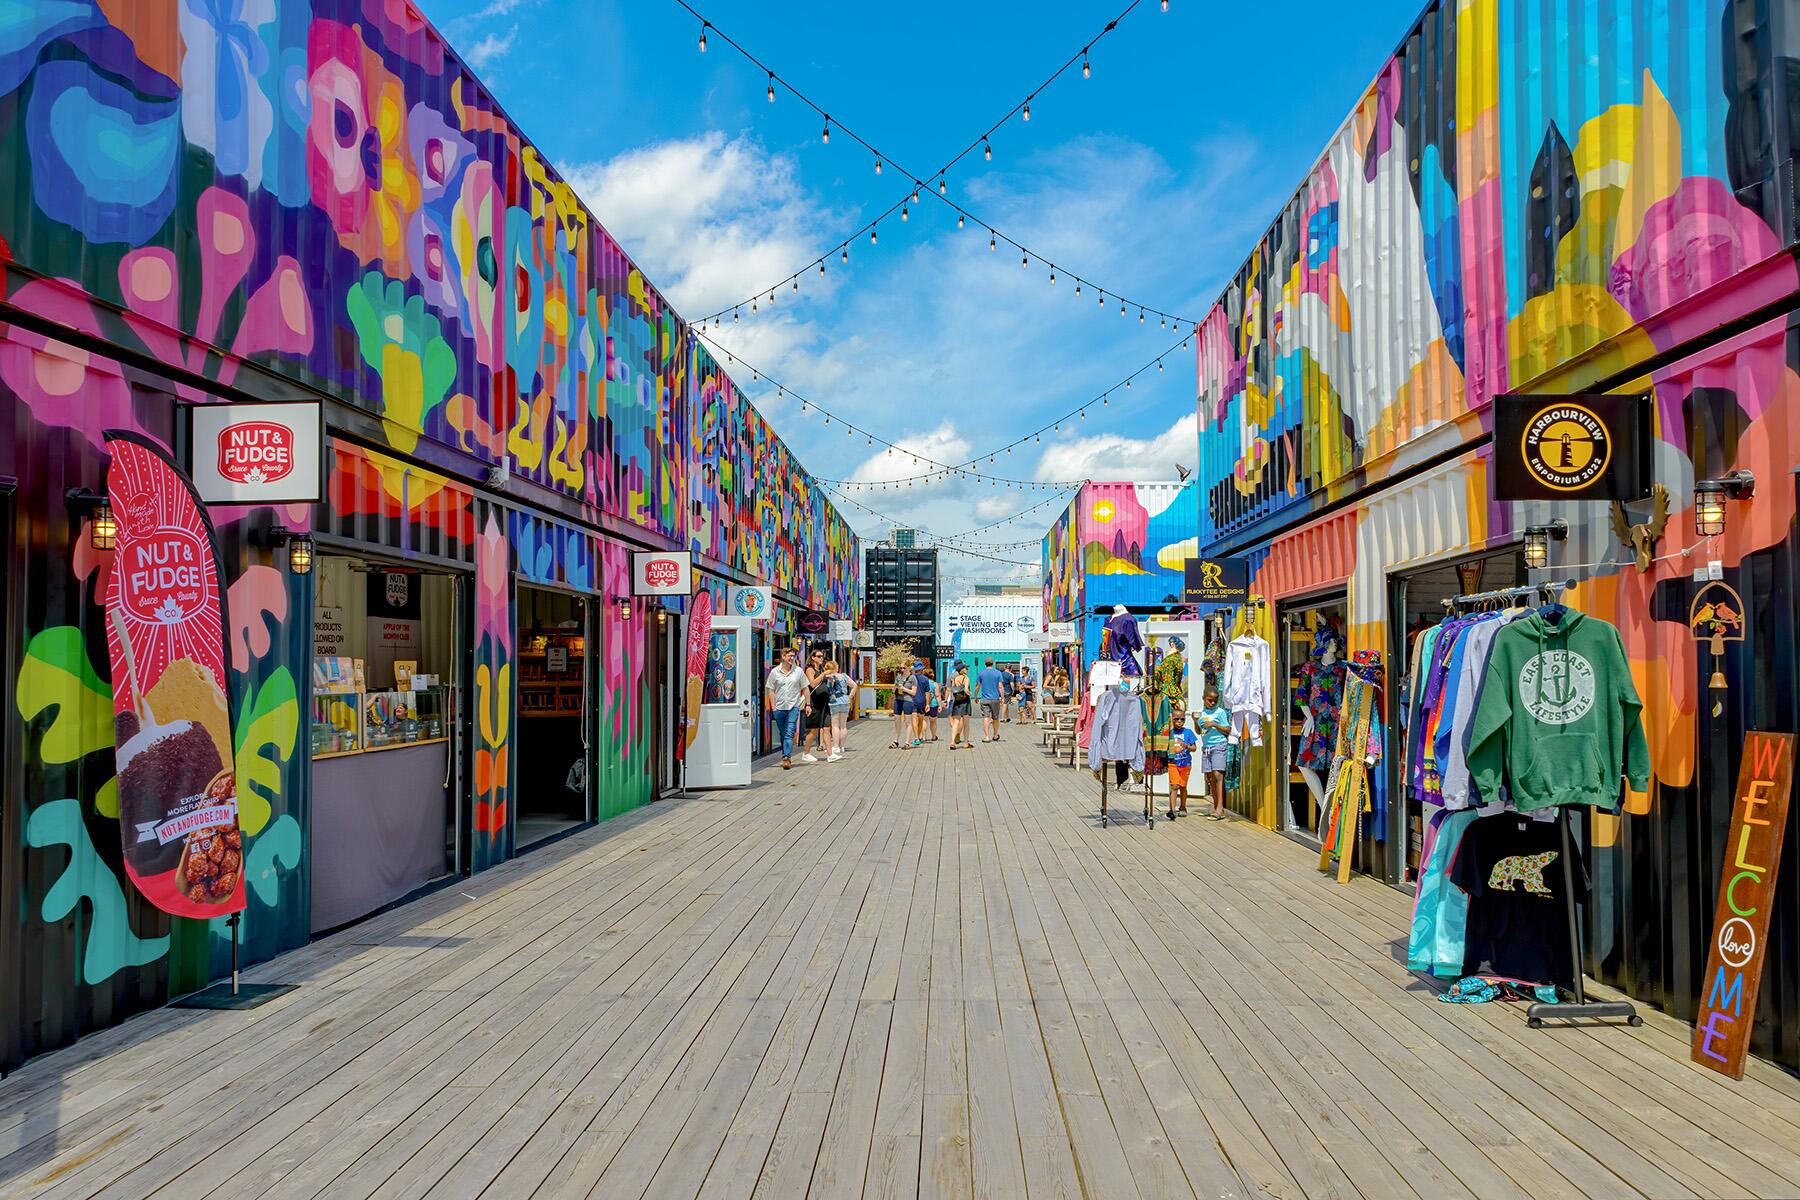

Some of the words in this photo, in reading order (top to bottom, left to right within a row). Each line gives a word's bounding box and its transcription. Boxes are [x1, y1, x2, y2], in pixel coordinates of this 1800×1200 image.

[1528, 409, 1604, 445] HARBOURVIEW
[224, 446, 289, 465] FUDGE
[1531, 457, 1581, 485] EMPORIUM
[1581, 457, 1602, 480] 2022
[131, 565, 201, 595] FUDGE
[648, 570, 677, 579] FUDGE
[387, 583, 407, 595] FUDGE
[322, 610, 333, 620] ALL
[314, 634, 336, 643] LOWED
[335, 635, 344, 643] ON
[317, 645, 337, 655] BOARD
[1522, 656, 1548, 685] EAST
[1553, 653, 1591, 678] COAST
[1529, 695, 1591, 721] LIFESTYLE
[167, 804, 189, 817] MORE
[188, 796, 220, 812] FLAVOURS
[180, 792, 208, 805] EXPLORE
[160, 809, 230, 840] NUTANDFUDGE.COM
[1721, 927, 1751, 956] love
